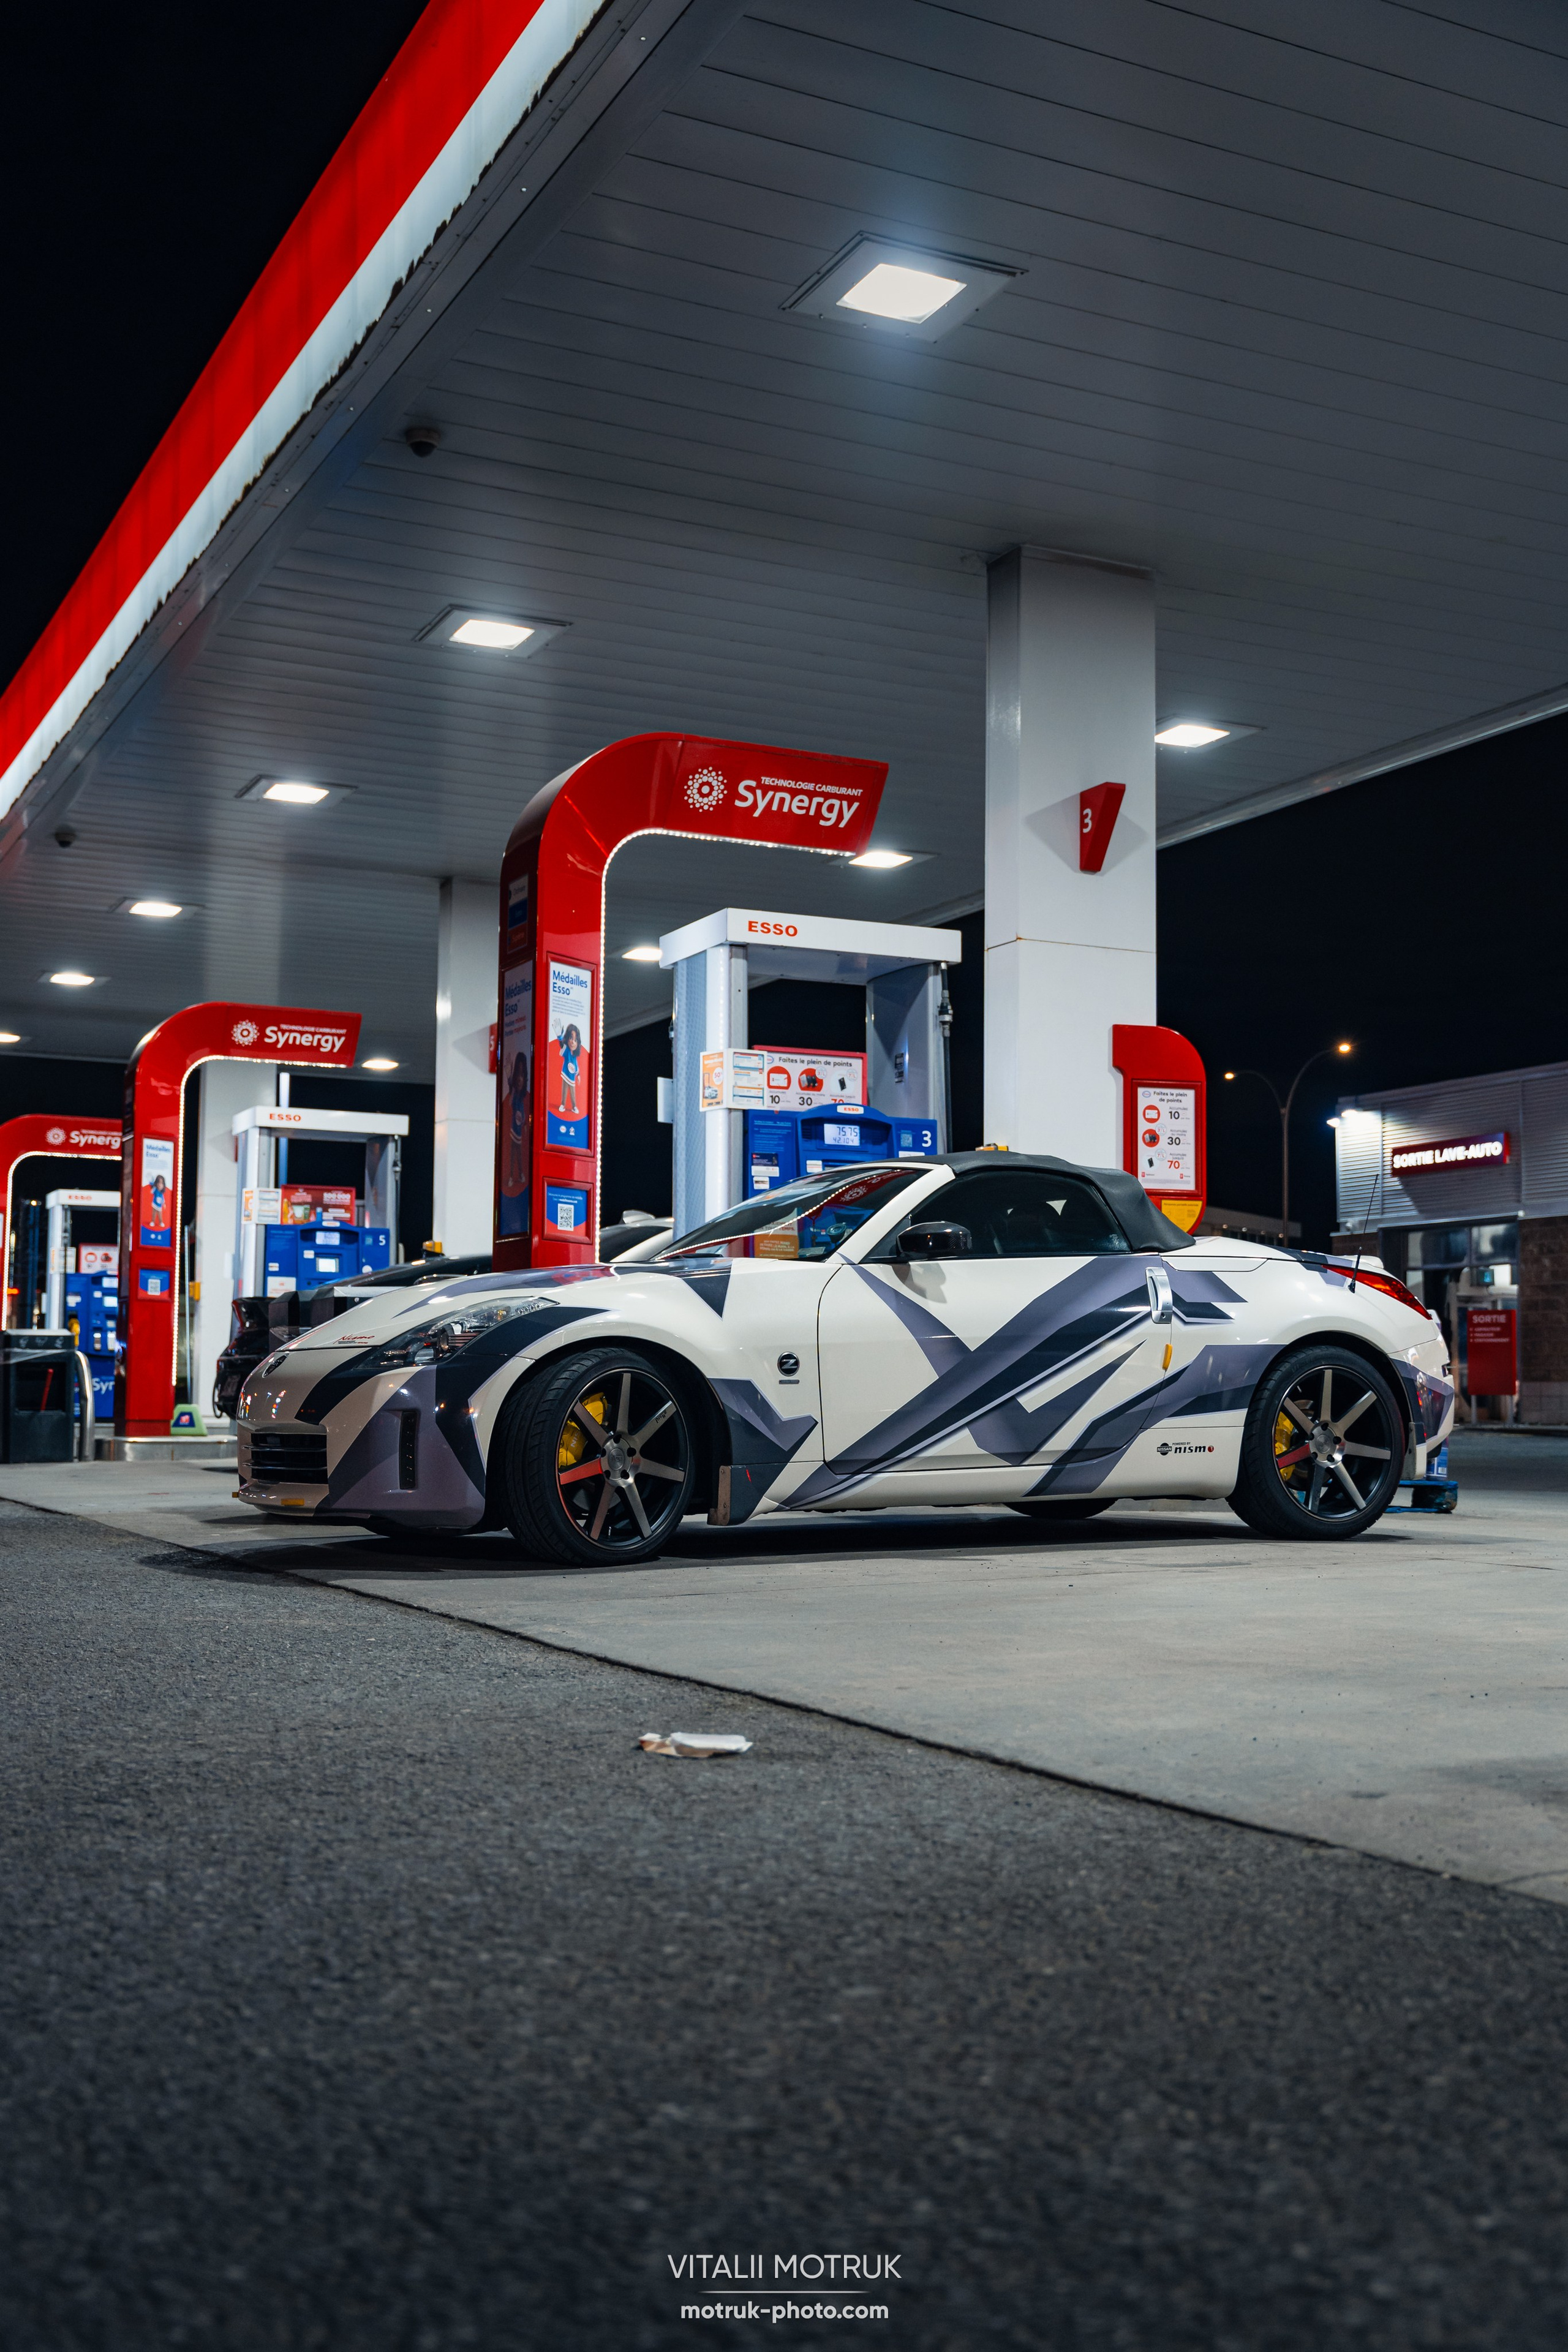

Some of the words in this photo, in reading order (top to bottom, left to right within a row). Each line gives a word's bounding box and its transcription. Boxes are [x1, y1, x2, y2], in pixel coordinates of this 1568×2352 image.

[761, 777, 815, 791] TECHNOLOGIE
[815, 784, 863, 797] CARBURANT
[735, 780, 859, 827] Synergy
[1082, 808, 1092, 833] 3
[748, 921, 798, 937] ESSO
[552, 970, 588, 988] Médailles
[552, 982, 570, 995] Esso
[264, 1026, 345, 1053] Synergy
[769, 1095, 780, 1104] 10
[799, 1096, 813, 1106] 30
[270, 1113, 301, 1122] ESSO
[1169, 1111, 1180, 1120] 10
[69, 1130, 121, 1149] Synerg
[922, 1130, 932, 1147] 3
[1167, 1137, 1181, 1145] 30
[1393, 1150, 1434, 1168] SORTIE
[1435, 1141, 1502, 1163] LAVE-AUTO
[1167, 1160, 1180, 1169] 70
[379, 1235, 386, 1246] 5
[1472, 1314, 1506, 1323] SORTIE
[781, 1359, 797, 1369] Z
